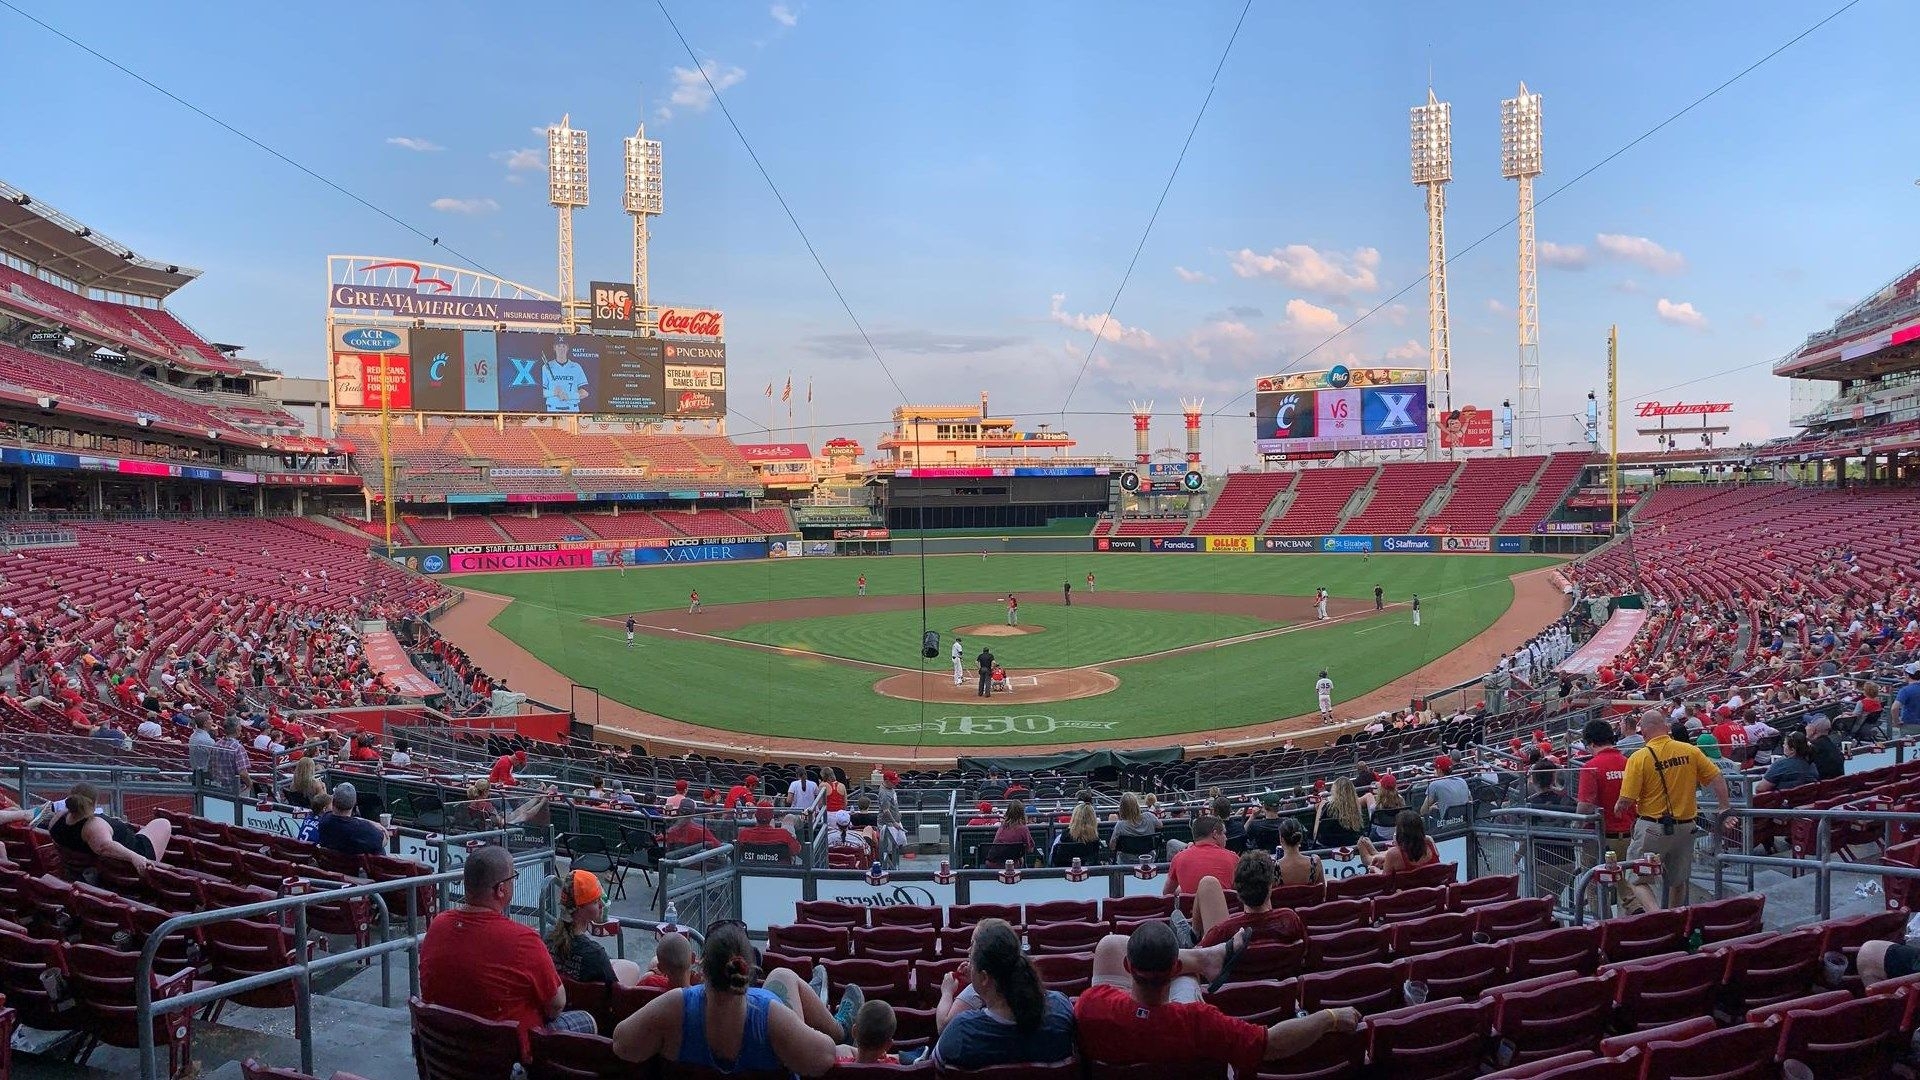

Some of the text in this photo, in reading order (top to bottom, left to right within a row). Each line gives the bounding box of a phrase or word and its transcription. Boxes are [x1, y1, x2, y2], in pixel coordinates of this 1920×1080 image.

[336, 287, 406, 308] GREAT
[503, 311, 538, 320] INSURANCE
[540, 313, 562, 321] GROUP
[596, 289, 628, 307] BIG
[659, 309, 722, 336] Coca-Cola
[360, 330, 384, 339] ACR
[351, 339, 392, 348] CONCRETE
[676, 347, 724, 360] PNC BANK
[475, 360, 489, 377] VS
[667, 369, 691, 378] STREAM
[673, 378, 708, 387] GAMES LIVE
[1333, 372, 1349, 381] P&G
[569, 383, 574, 392] 7
[1330, 398, 1348, 419] VS
[1637, 401, 1733, 417] Budweiser
[31, 453, 56, 465] XAVIER
[448, 546, 483, 555] NOCO
[485, 545, 506, 553] START
[507, 544, 524, 552] DEAD
[636, 540, 667, 548] STARTERS
[669, 539, 699, 547] NOCO
[1164, 541, 1195, 549] Fanatics
[1275, 540, 1313, 548] PNC BANK
[1395, 539, 1429, 548] Staffmark
[607, 551, 623, 565] VS
[663, 546, 734, 562] XAVIER
[461, 554, 586, 570] CINCINNATI
[1730, 733, 1747, 747] 66
[279, 754, 290, 763] 22
[1508, 760, 1518, 770] 23
[299, 826, 314, 842] 5
